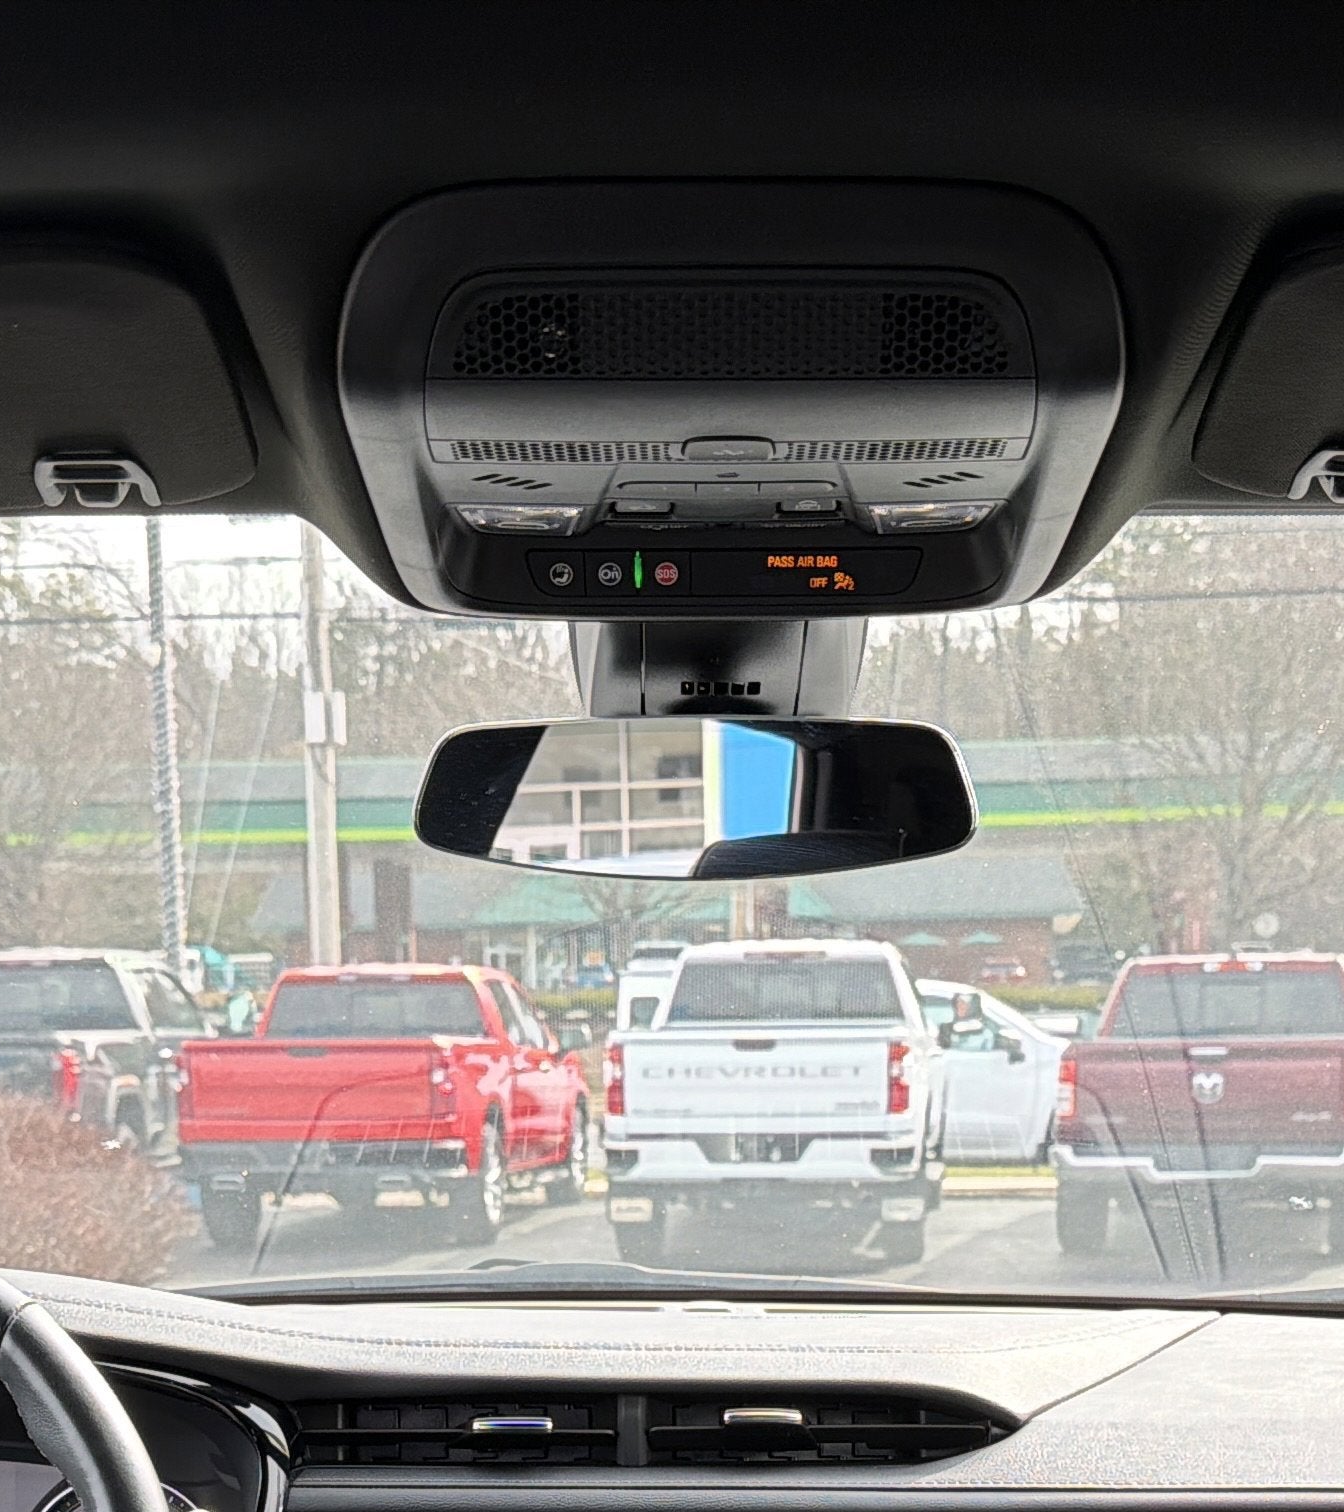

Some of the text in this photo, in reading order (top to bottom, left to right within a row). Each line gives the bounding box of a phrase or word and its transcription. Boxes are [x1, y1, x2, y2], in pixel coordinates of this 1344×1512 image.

[767, 555, 838, 568] PASS AIR BAG
[657, 568, 677, 579] SOS
[809, 577, 828, 588] OFF
[642, 1065, 863, 1079] CHEVROLET
